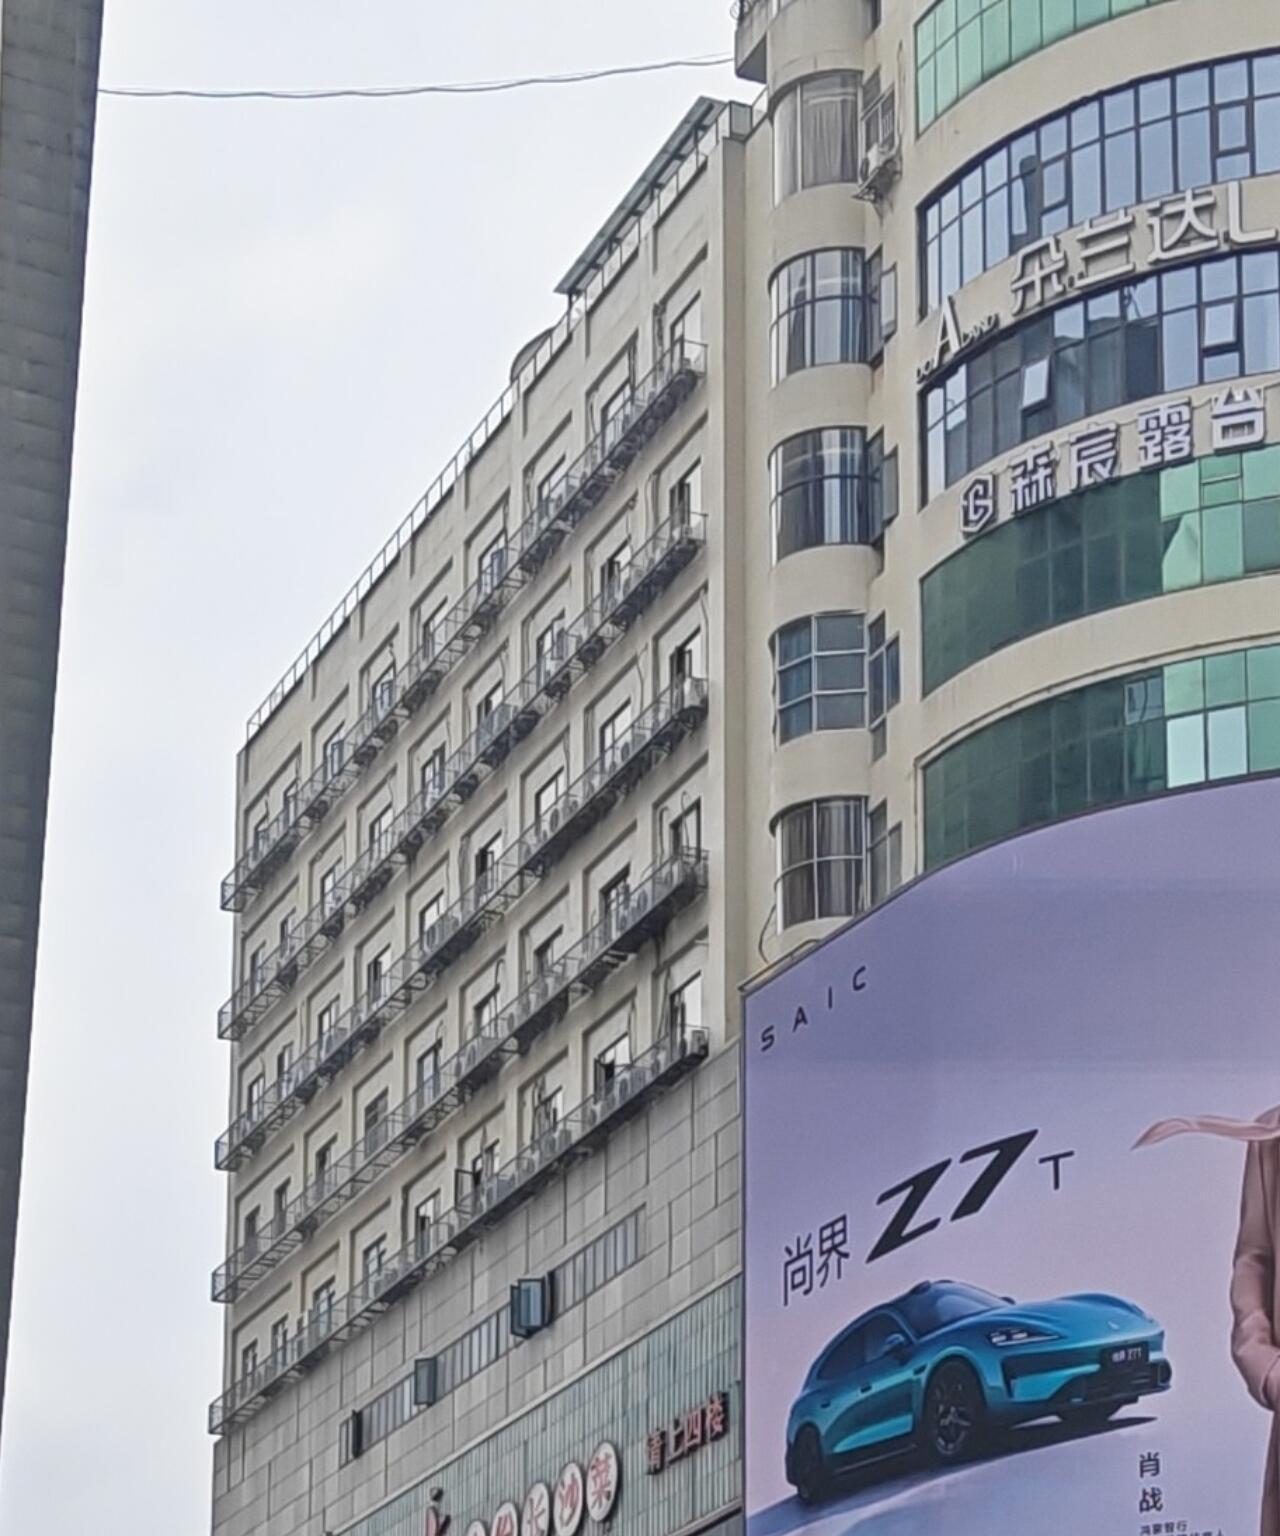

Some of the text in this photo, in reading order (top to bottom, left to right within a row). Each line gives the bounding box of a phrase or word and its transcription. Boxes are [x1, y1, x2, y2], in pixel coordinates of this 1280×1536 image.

[759, 966, 868, 1053] SAIC
[783, 1214, 851, 1307] 尚界
[1139, 1451, 1164, 1513] 肖战
